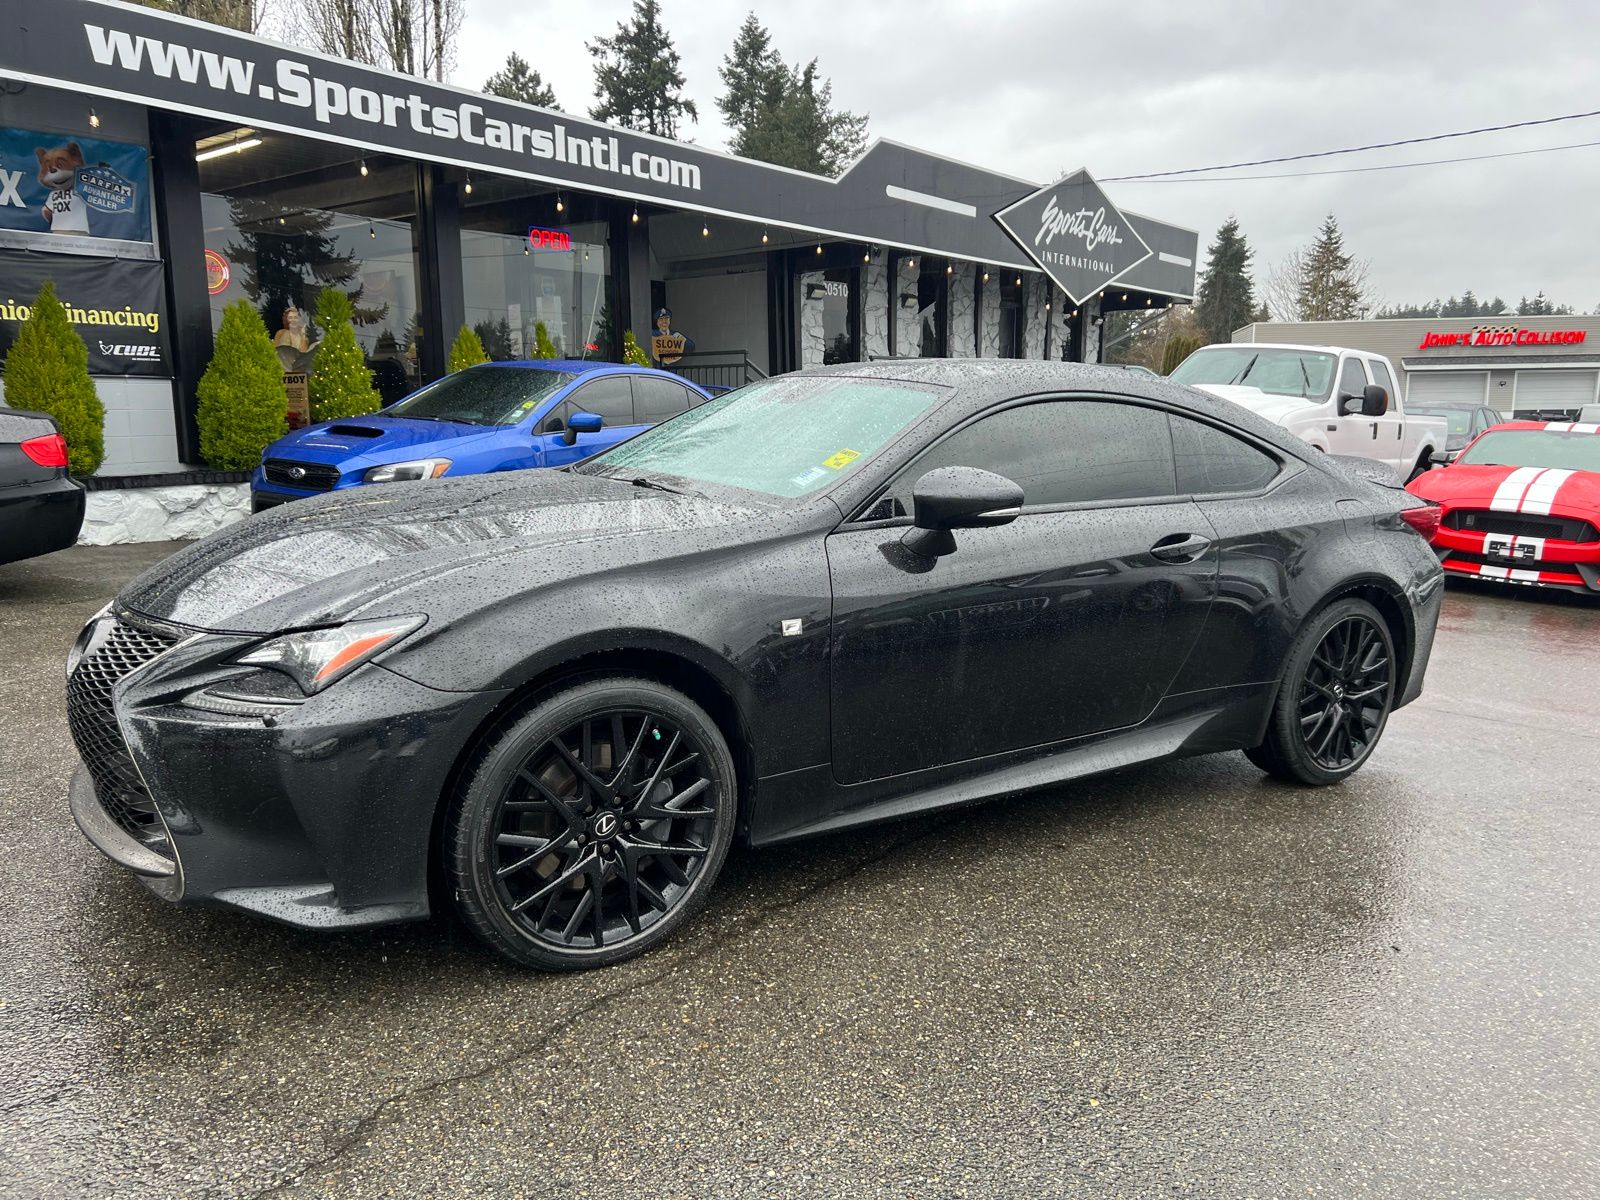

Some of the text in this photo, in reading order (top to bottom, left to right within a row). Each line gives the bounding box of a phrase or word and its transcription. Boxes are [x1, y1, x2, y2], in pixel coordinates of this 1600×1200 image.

[81, 173, 131, 196] CARFAX
[52, 189, 71, 202] CAR
[83, 185, 126, 205] ADVANTAGE
[87, 194, 118, 211] DEALER
[53, 201, 71, 213] FOX
[530, 229, 569, 250] OPEN
[1042, 250, 1115, 274] INTERNATIONAL
[60, 302, 159, 333] inancing
[656, 339, 682, 349] SLOW
[1475, 330, 1513, 346] AUTO
[1516, 329, 1586, 346] COLLISION
